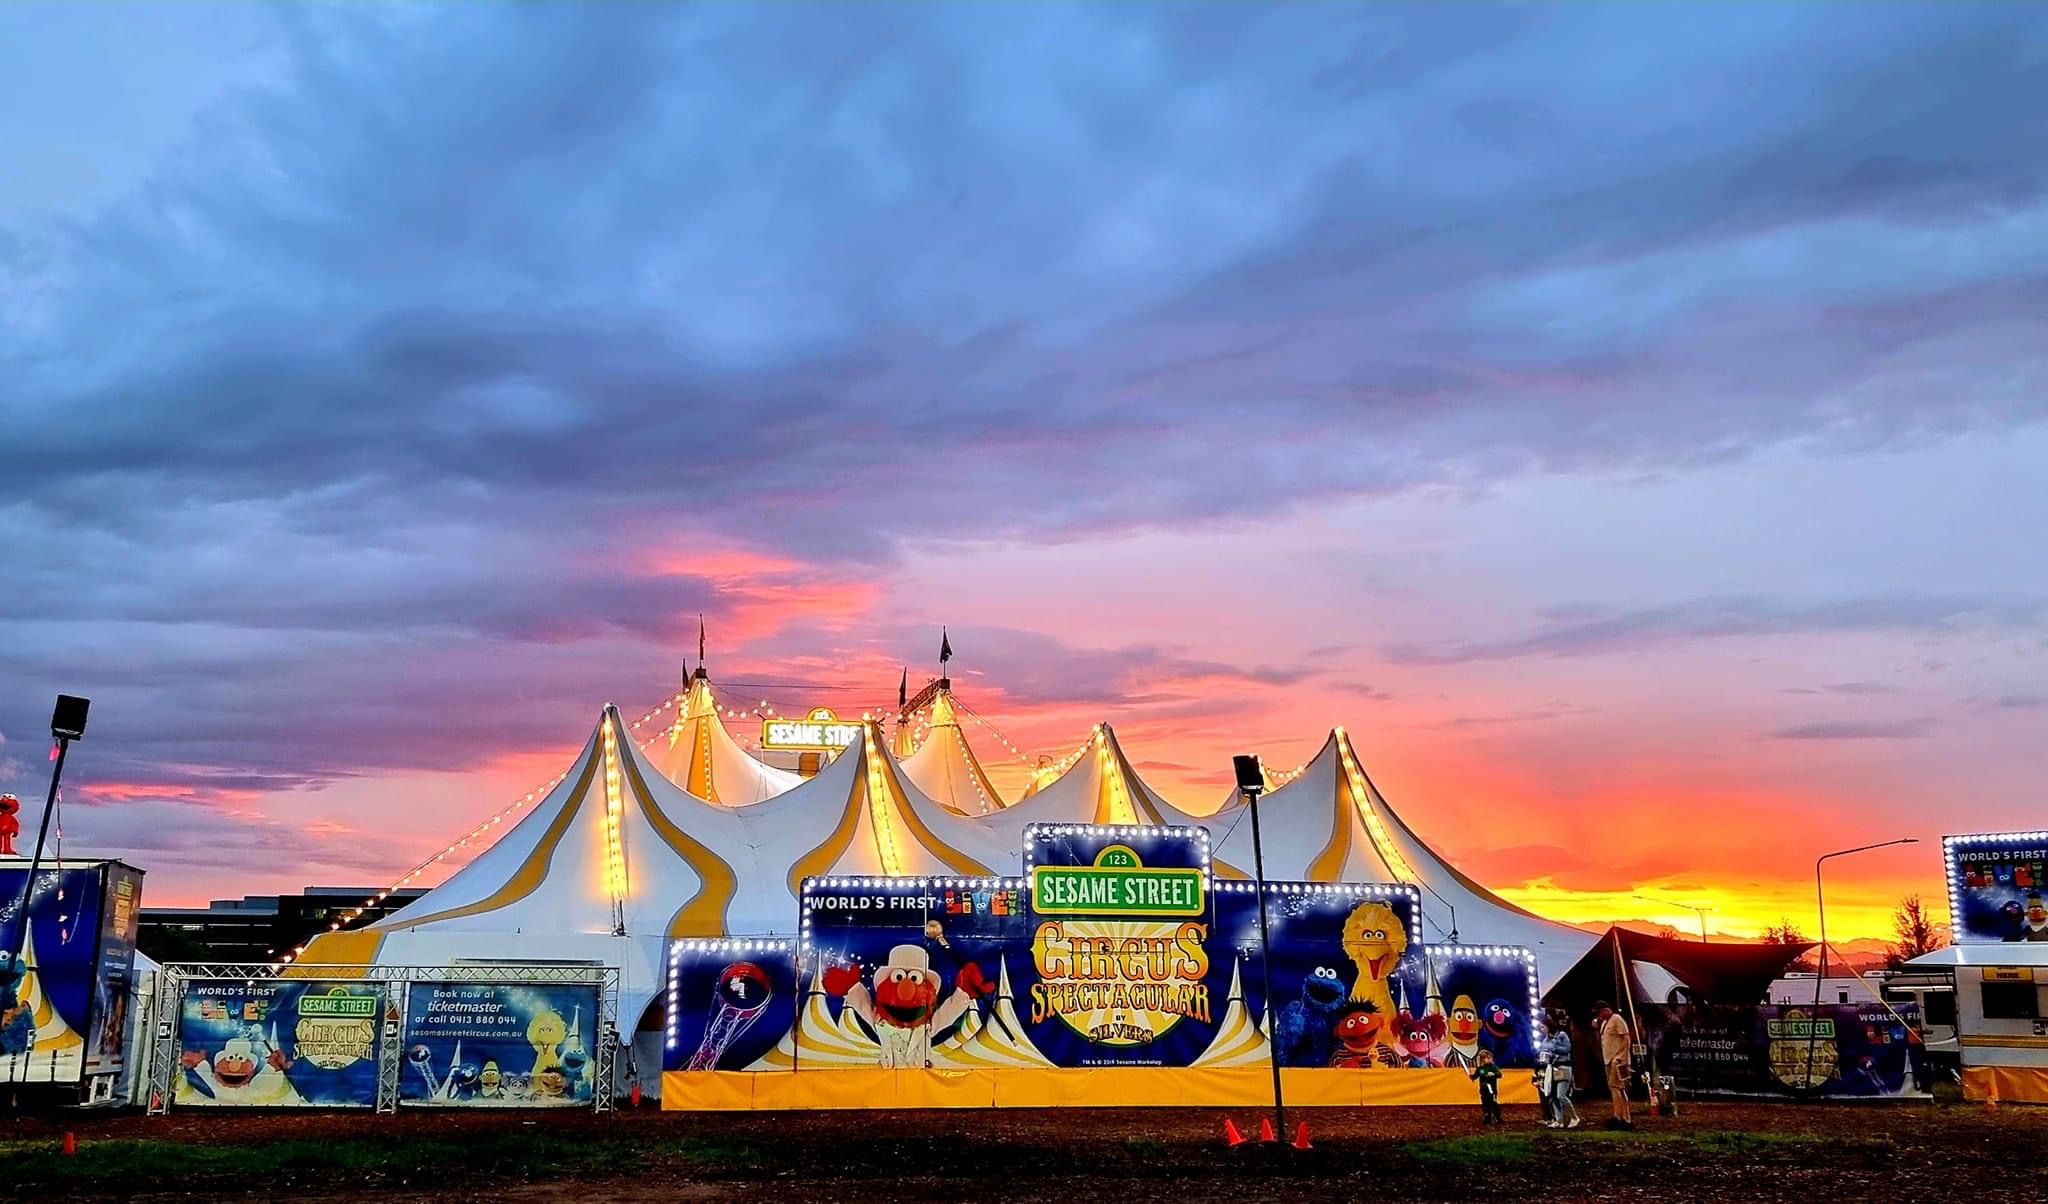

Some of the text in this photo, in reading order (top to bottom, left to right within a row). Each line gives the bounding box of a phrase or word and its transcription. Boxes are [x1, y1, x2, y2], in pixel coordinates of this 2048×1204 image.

[768, 724, 822, 744] SESAME
[1108, 854, 1128, 866] 123
[1958, 850, 2047, 861] WORLD'S FIRST
[1043, 876, 1194, 905] SESAME STREET
[810, 895, 936, 909] WORLD'S FIRST
[1030, 920, 1209, 981] CIRCUS
[197, 988, 276, 996] WORLD'S FIRST
[433, 989, 494, 998] Book now at
[303, 1000, 372, 1012] SESAME STREET
[427, 1000, 503, 1013] ticketmaster
[1030, 982, 1211, 1024] SPECTACULAR
[429, 1015, 446, 1024] call
[450, 1016, 472, 1024] 0413
[498, 1016, 516, 1024] 044
[1859, 1013, 1904, 1021] WORLDS
[295, 1018, 376, 1044] CIRCUS
[1088, 1024, 1154, 1044] SILVERS
